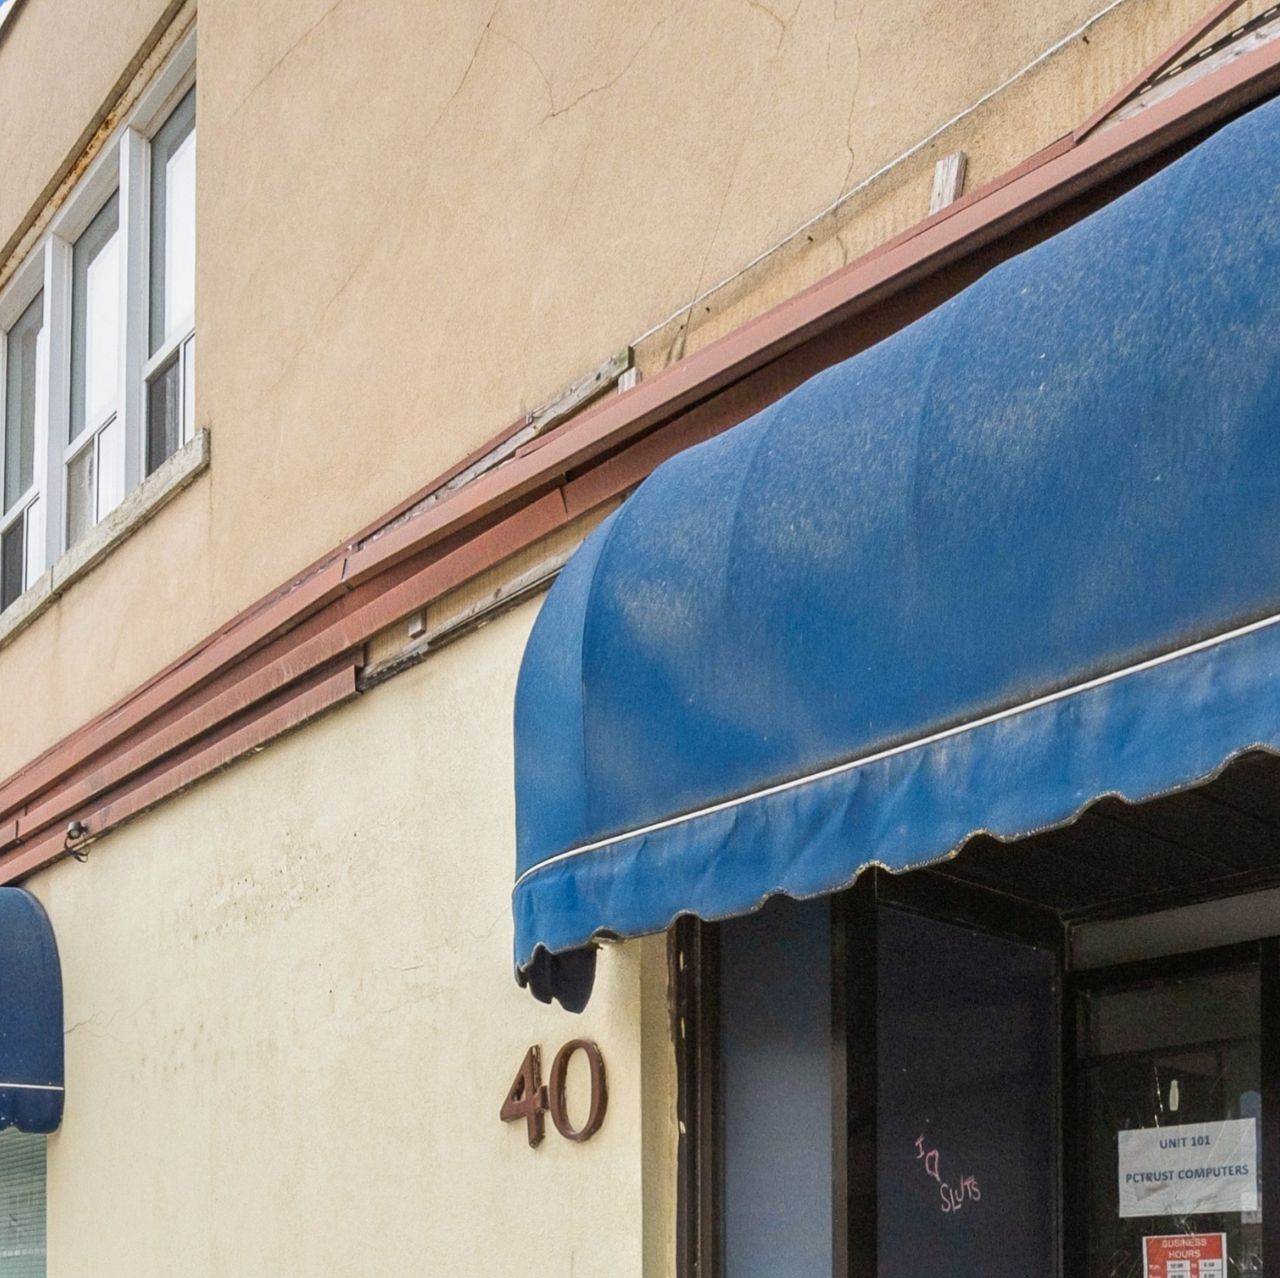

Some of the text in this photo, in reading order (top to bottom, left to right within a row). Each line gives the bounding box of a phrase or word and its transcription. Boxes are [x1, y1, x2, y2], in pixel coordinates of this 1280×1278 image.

[500, 1039, 609, 1149] 40
[1159, 1135, 1211, 1150] UNIT 101
[1126, 1164, 1250, 1184] PCTRUST COMPUTERS
[940, 1174, 982, 1214] SLUTS
[1161, 1238, 1208, 1249] BUSINESS
[1168, 1249, 1201, 1259] HOURS
